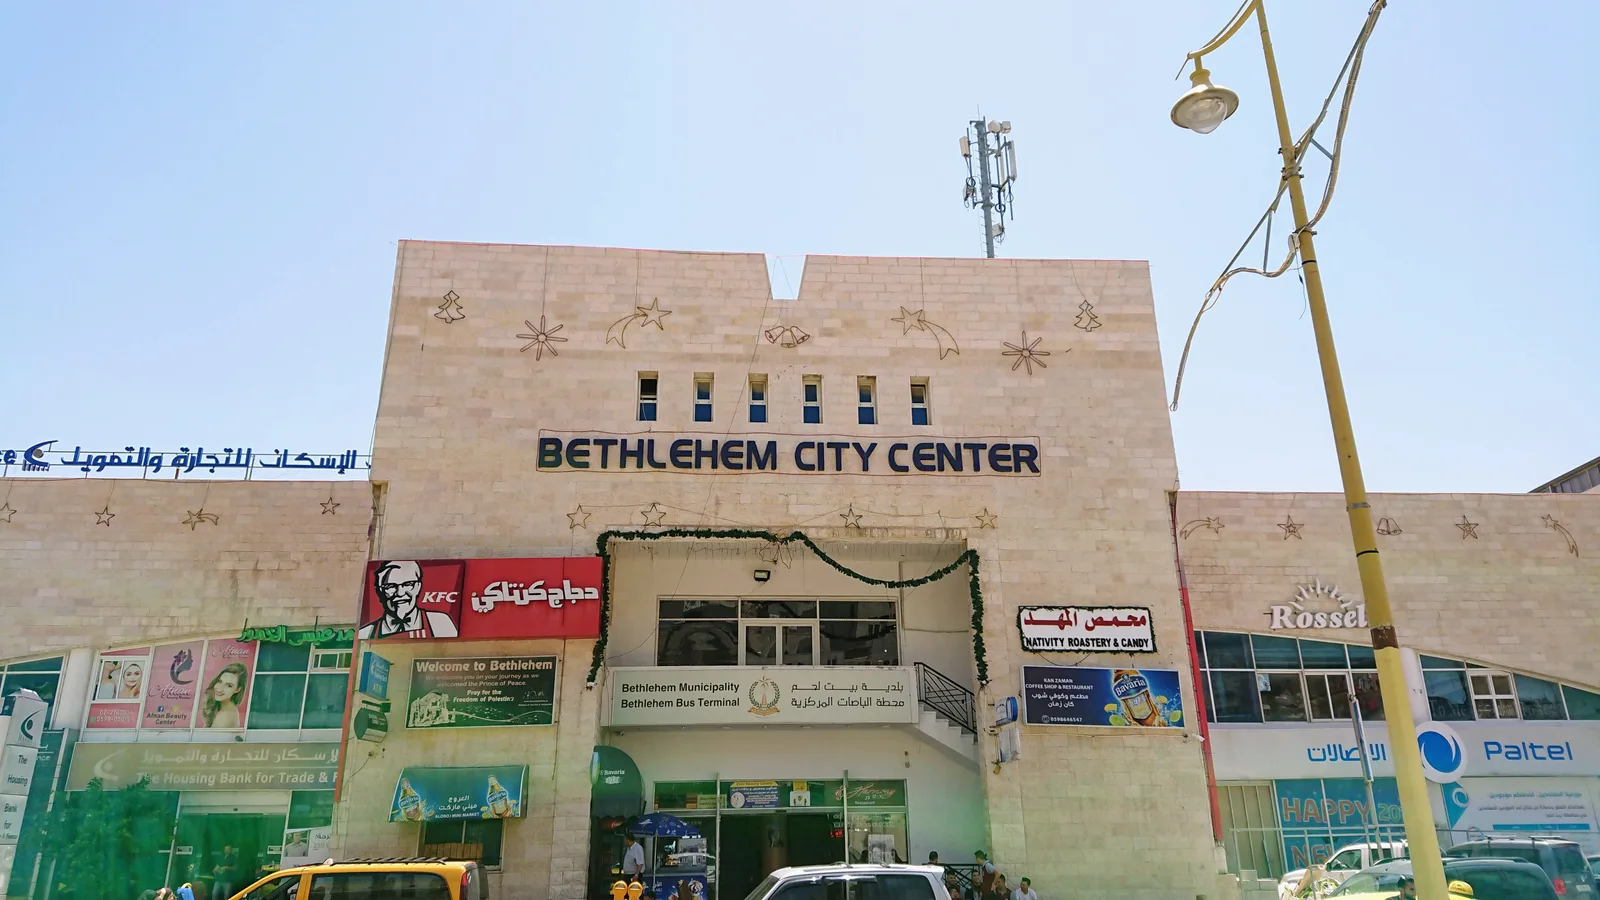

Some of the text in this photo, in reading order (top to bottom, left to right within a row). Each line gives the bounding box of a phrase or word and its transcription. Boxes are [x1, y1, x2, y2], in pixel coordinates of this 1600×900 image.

[61, 446, 357, 474] الإسكان للتجارة والتمويل
[538, 437, 1040, 474] BETHLEHEM CITY CENTER
[422, 592, 458, 603] KFC
[548, 580, 599, 608] دجاج
[1024, 609, 1147, 631] محمص المهد
[1270, 604, 1368, 629] Rossel
[1026, 637, 1149, 648] NATIVITY ROASTERY & CANDY
[416, 659, 552, 672] Welcome to Bethlehem
[466, 689, 481, 697] Pray
[621, 682, 740, 693] Bethlehem Municipality
[791, 681, 904, 693] بلدية بيت لحم
[1115, 678, 1147, 696] Bavaria
[621, 698, 740, 708] Bethlehem Bus Terminal
[791, 697, 905, 708] محطة الباصات المركزية
[155, 717, 176, 725] Center
[165, 712, 187, 720] Beauty
[275, 748, 339, 764] لإسكان
[1307, 742, 1387, 762] الاصالات
[1484, 741, 1574, 761] Paltel
[18, 754, 28, 764] The
[7, 774, 28, 787] Housing
[164, 771, 215, 786] Housing
[220, 771, 251, 784] Bank
[256, 771, 275, 784] for
[279, 771, 315, 784] Trade
[319, 771, 328, 783] &
[4, 803, 18, 813] Bank
[1282, 797, 1403, 824] HAPPY 20
[4, 820, 12, 830] for
